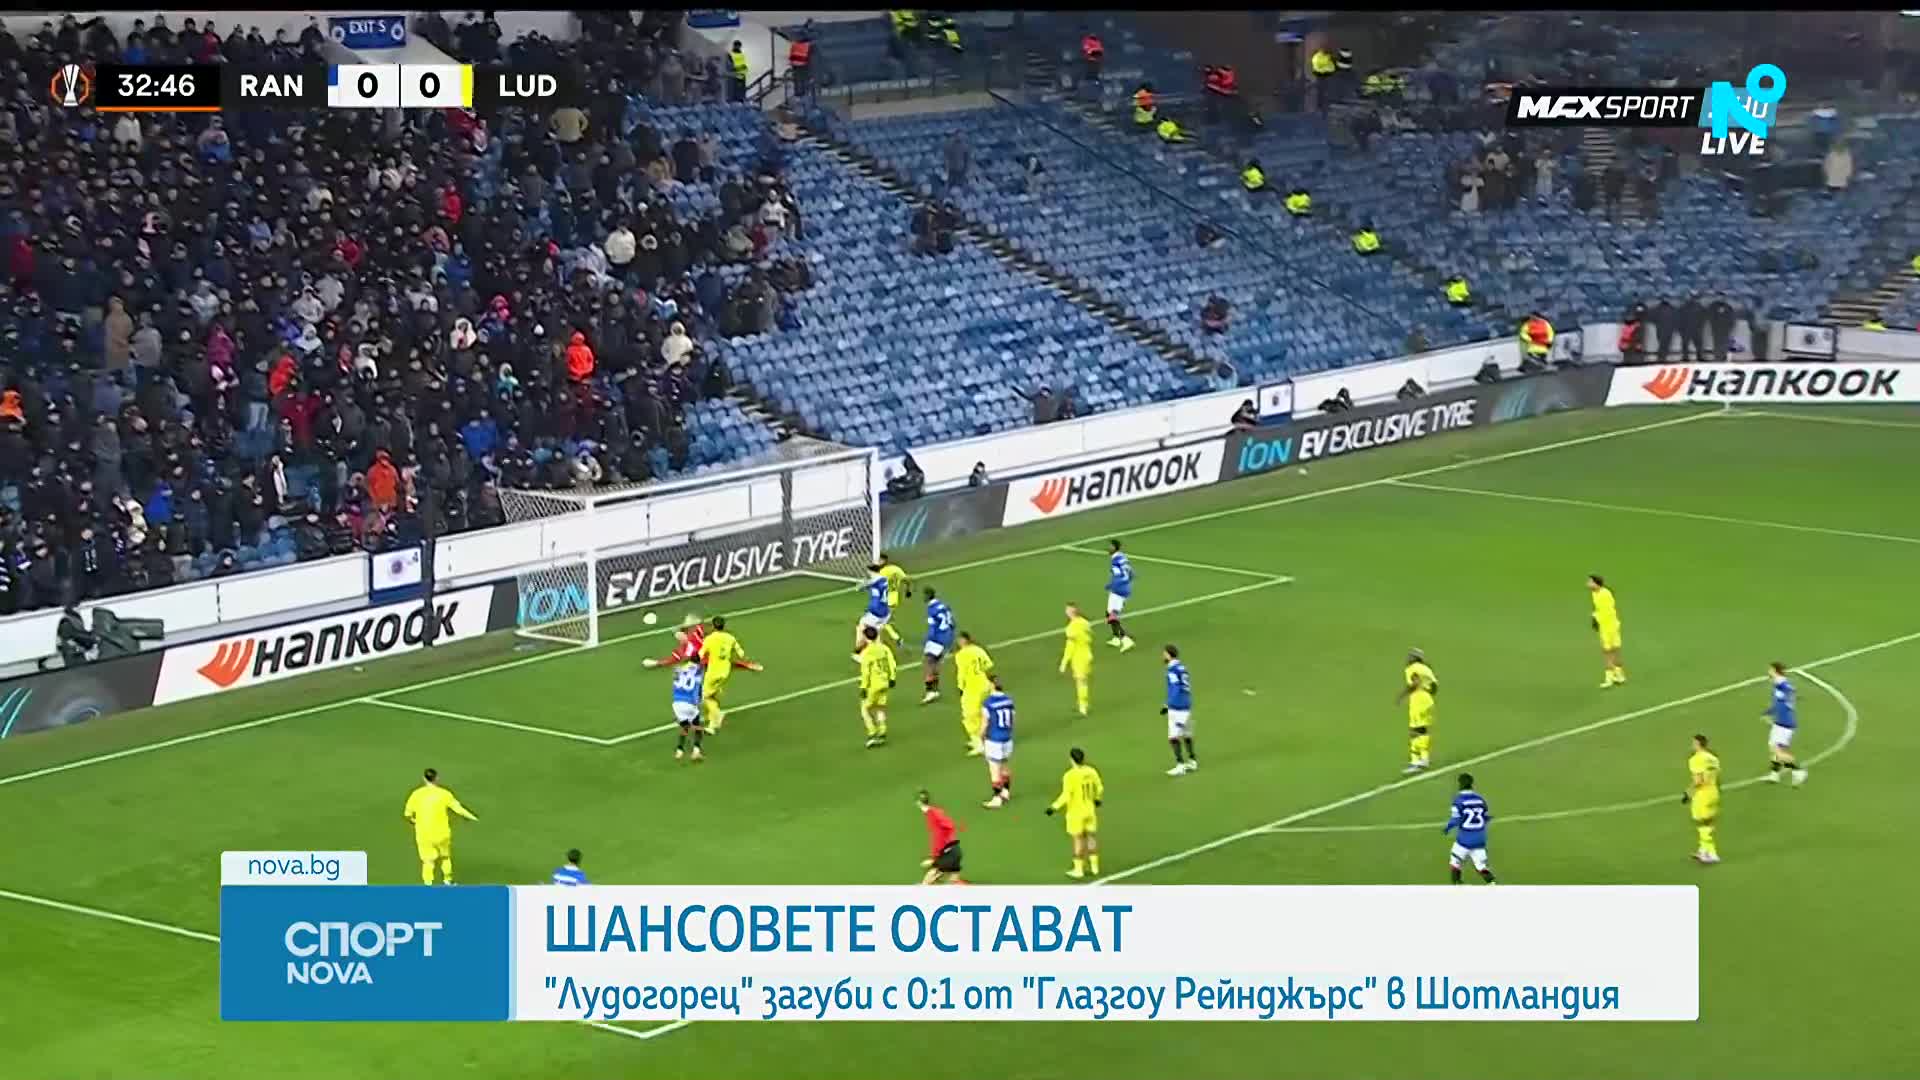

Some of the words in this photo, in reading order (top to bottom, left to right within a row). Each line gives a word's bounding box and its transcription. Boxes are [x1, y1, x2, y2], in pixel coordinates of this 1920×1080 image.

[349, 20, 375, 34] EXIT
[1298, 428, 1330, 461] EV
[1328, 408, 1430, 455] EXCLUSIVE
[1431, 399, 1477, 433] TYRE
[605, 567, 646, 608] EV
[648, 541, 784, 599] EXCLUSIVE
[792, 526, 853, 568] TYRE
[1462, 807, 1485, 829] 23
